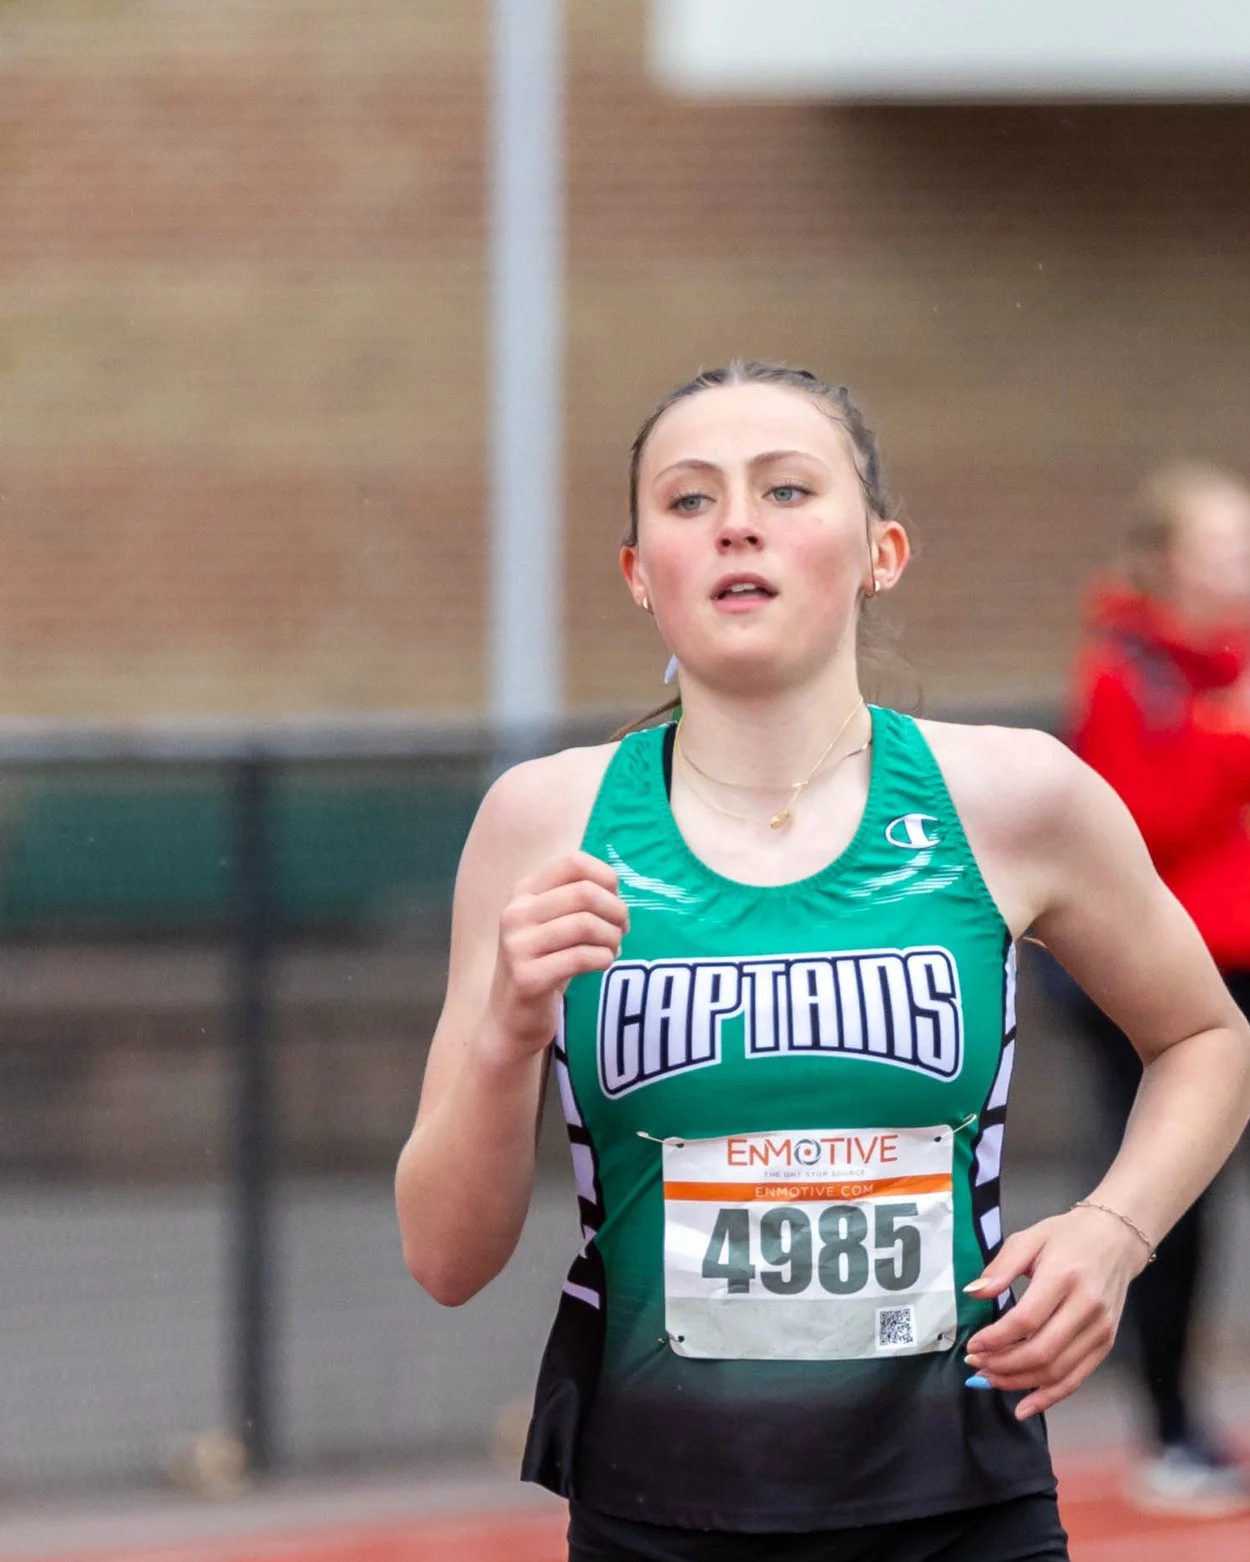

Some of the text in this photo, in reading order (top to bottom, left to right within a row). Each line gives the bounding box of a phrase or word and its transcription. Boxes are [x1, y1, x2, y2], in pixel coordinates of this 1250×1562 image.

[597, 946, 964, 1100] CAPTAINS
[755, 1183, 874, 1199] ENMOTIVECOM
[701, 1202, 921, 1295] 4985
